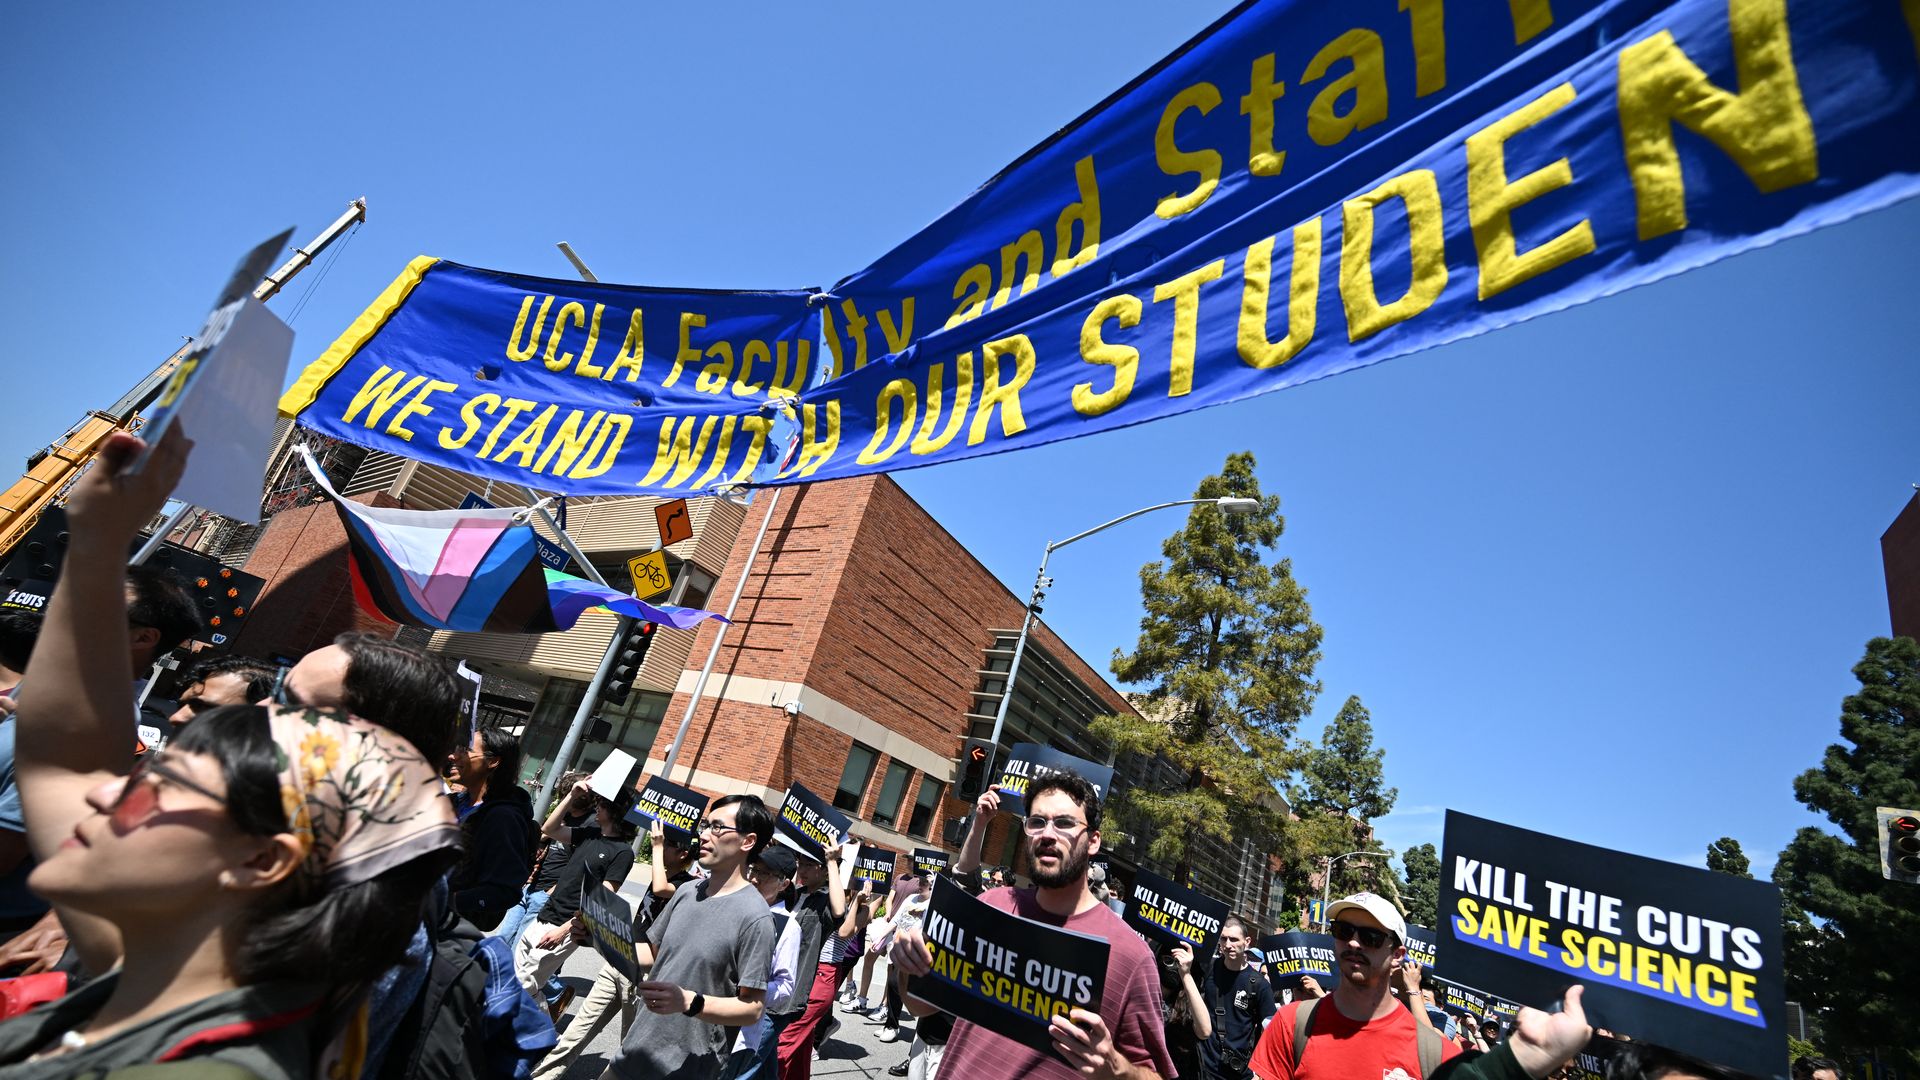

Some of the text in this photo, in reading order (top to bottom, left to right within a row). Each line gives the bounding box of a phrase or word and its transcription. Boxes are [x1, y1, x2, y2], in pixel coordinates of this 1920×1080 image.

[341, 0, 1920, 490] WE STAND WITH OUR STUDEN
[505, 295, 644, 382] UCLA
[943, 154, 1101, 330] and
[14, 592, 46, 608] CUTS
[1004, 759, 1030, 777] KILL
[636, 799, 694, 831] SAVE SCIENCE
[642, 788, 700, 820] KILL THE CUTS
[787, 795, 840, 839] KILL THE CUTS
[782, 806, 830, 846] SAVE SCIENC
[863, 858, 876, 870] THE
[877, 861, 892, 873] CUTS
[870, 870, 886, 882] LIVES
[592, 900, 608, 928] THE
[608, 912, 633, 943] CUTS
[1134, 885, 1220, 934] KILL THE CUTS
[1139, 903, 1170, 928] SAVE
[1170, 918, 1206, 944] LIVES
[1454, 855, 1763, 970] KILL THE CUTS
[926, 909, 1093, 1005] KILL THE CUTS
[1266, 946, 1336, 964] KILL THE CUTS
[1405, 936, 1426, 952] THE
[1408, 949, 1435, 966] SCIE
[1456, 897, 1759, 1017] SAVE SCIENCE
[1276, 960, 1331, 975] SAVE LIVES
[1447, 986, 1463, 999] KILL
[1464, 992, 1475, 1004] THE
[1447, 995, 1466, 1008] SAVE
[1580, 1053, 1601, 1074] THE
